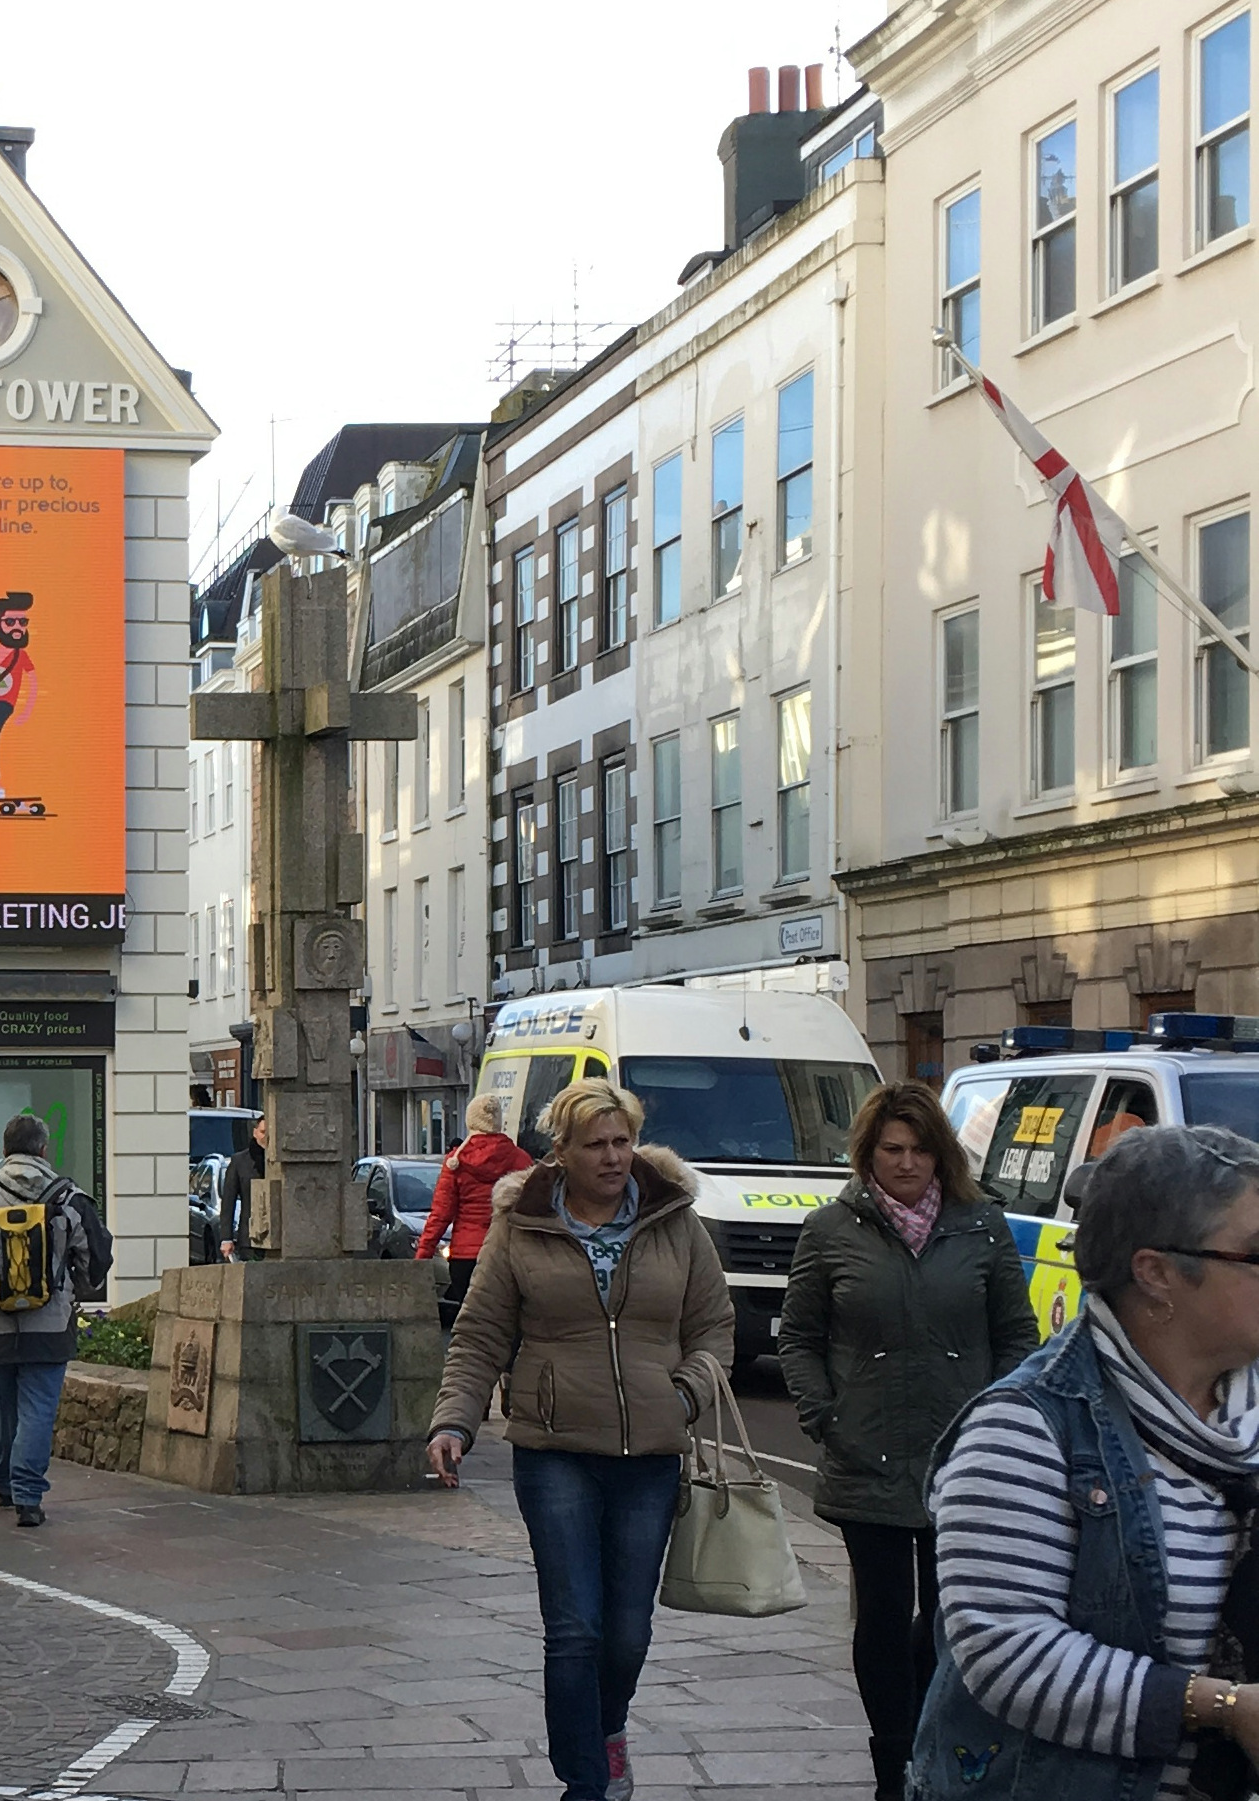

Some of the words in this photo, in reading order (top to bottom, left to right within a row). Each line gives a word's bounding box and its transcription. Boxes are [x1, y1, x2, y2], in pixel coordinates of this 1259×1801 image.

[19, 477, 44, 493] up
[49, 474, 73, 493] to,
[16, 497, 101, 516] precious
[784, 930, 798, 944] Post
[799, 926, 820, 943] Office
[43, 1011, 69, 1021] food
[503, 1004, 586, 1038] POLICE
[0, 1023, 43, 1034] CRAZY
[46, 1024, 86, 1036] prices!
[265, 1283, 327, 1299] SAINT
[337, 1282, 413, 1299] HELIER
